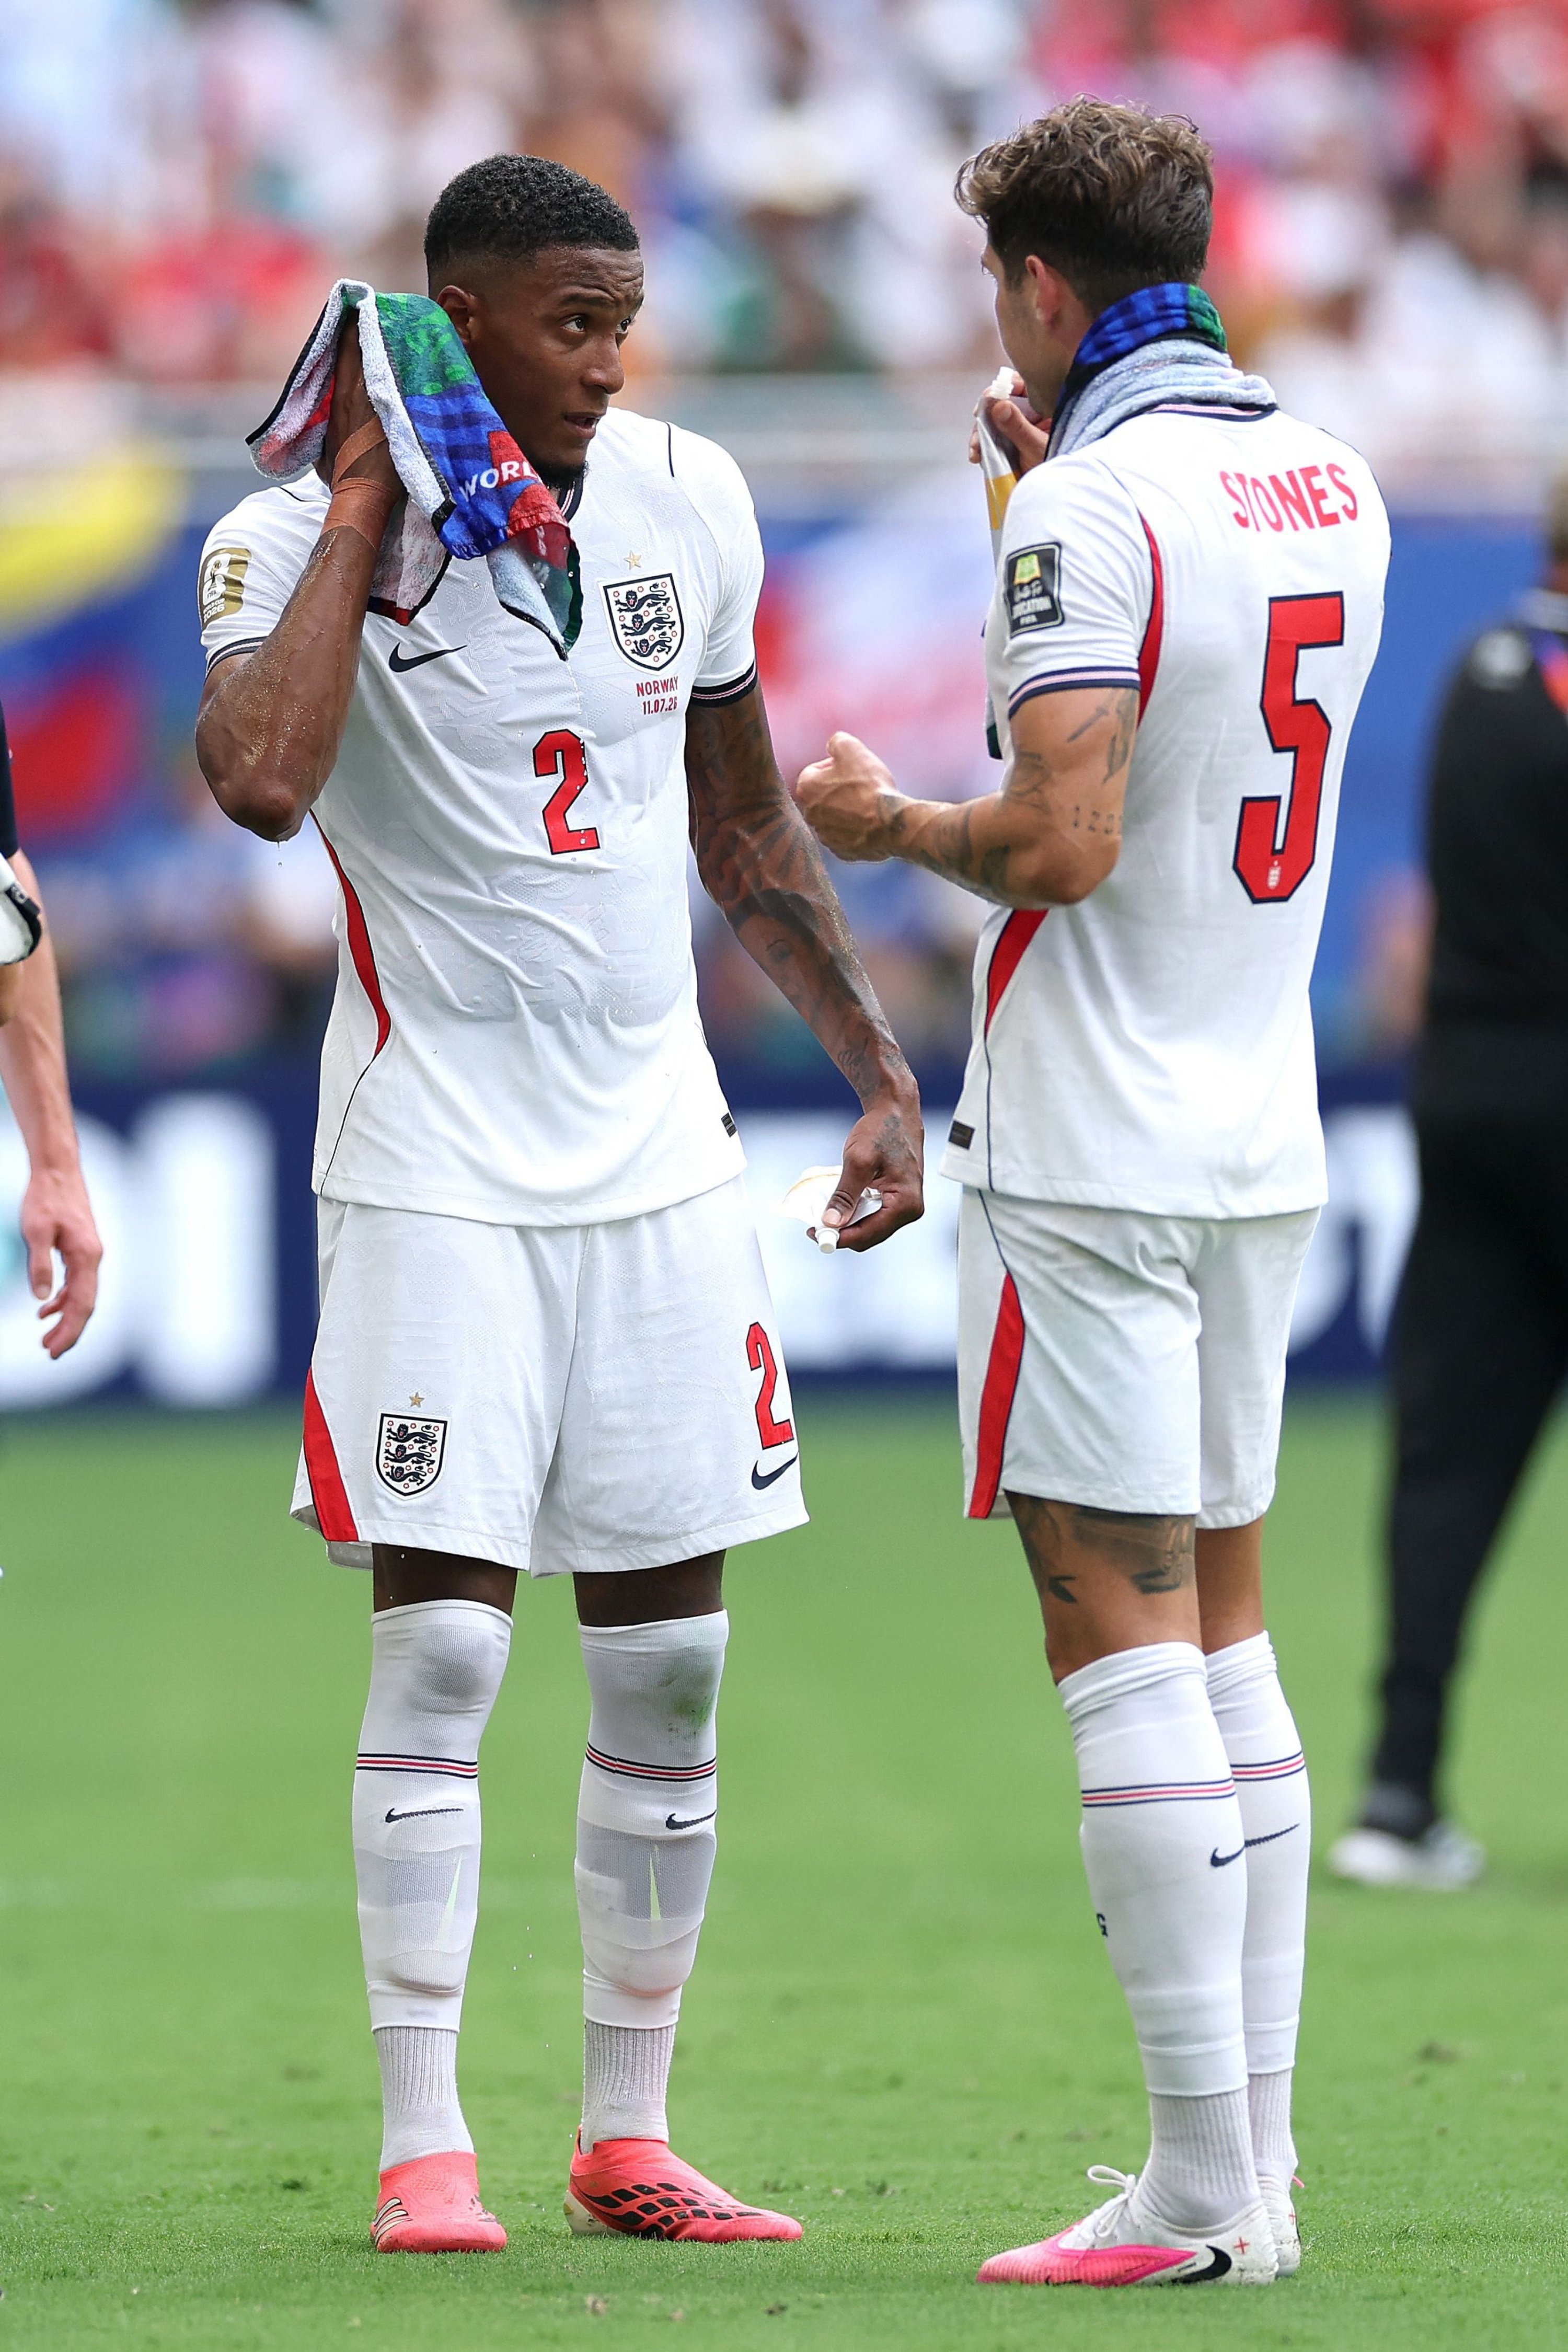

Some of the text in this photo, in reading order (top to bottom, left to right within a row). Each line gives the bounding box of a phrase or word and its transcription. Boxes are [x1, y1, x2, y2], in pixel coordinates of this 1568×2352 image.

[459, 460, 540, 502] WORL
[1219, 463, 1358, 532] STONES
[203, 603, 225, 623] 2026
[636, 676, 678, 697] NORWAY
[642, 696, 677, 715] 11.07.26
[1233, 591, 1344, 904] 5
[532, 729, 601, 856] 2
[746, 1321, 794, 1450] 2
